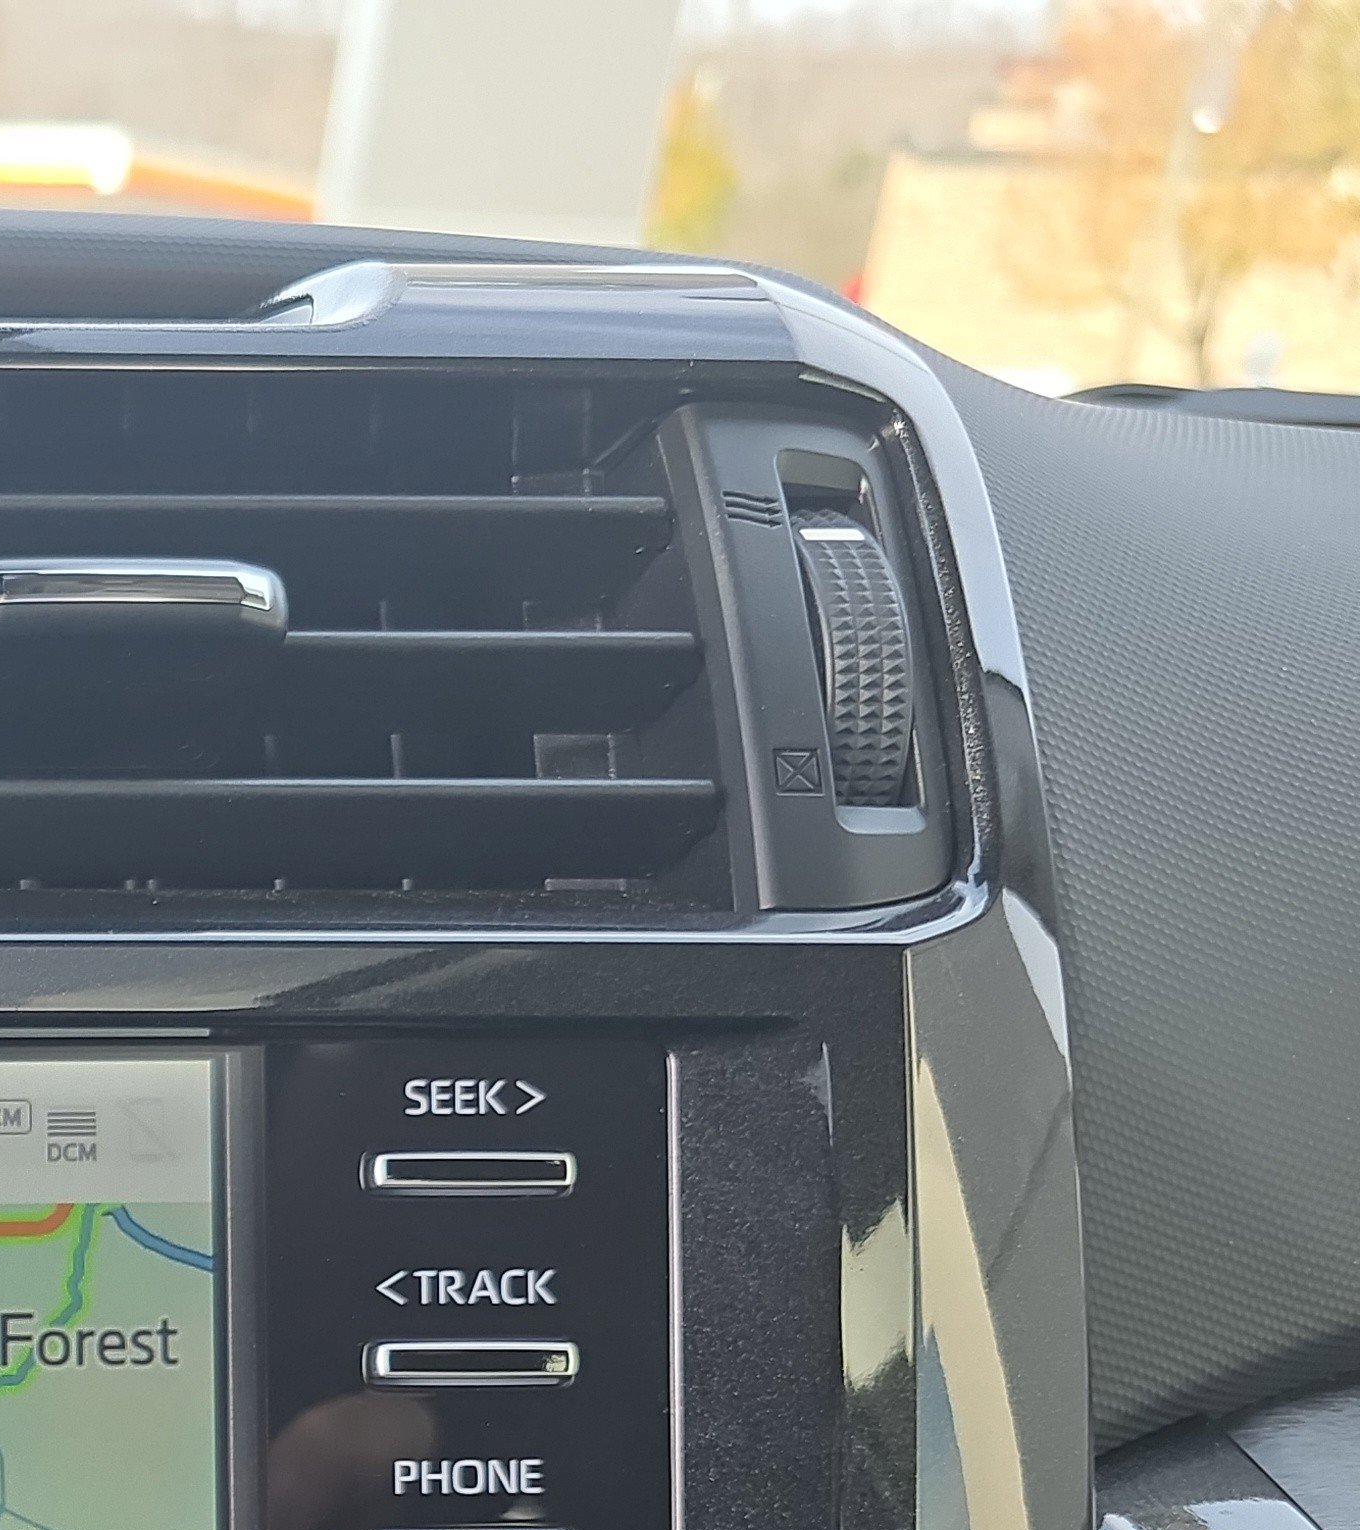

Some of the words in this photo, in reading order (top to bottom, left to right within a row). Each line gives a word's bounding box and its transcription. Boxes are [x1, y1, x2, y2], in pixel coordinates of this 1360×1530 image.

[47, 1143, 97, 1162] DCM
[411, 1268, 557, 1305] TRACK
[393, 1459, 545, 1495] PHONE
